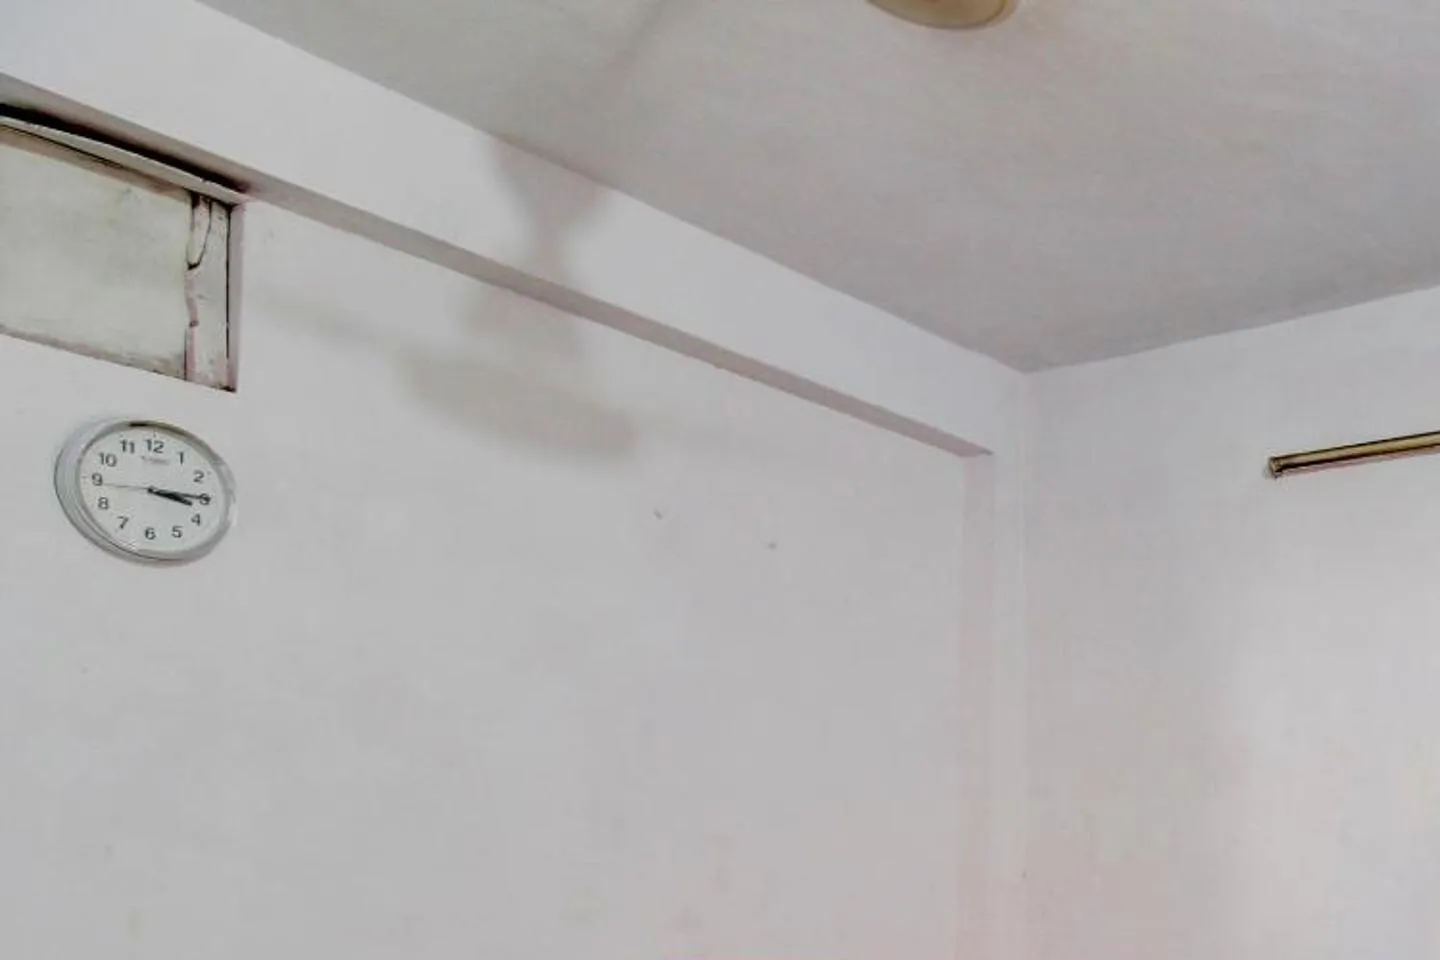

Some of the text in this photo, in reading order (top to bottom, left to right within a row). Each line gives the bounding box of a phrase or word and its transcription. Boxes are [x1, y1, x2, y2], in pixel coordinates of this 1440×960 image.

[120, 439, 135, 454] 11
[146, 439, 164, 453] 12
[100, 452, 117, 467] 10
[178, 452, 184, 464] 1
[92, 473, 103, 486] 9
[193, 470, 204, 482] 2
[98, 497, 109, 510] 8
[117, 516, 129, 529] 7
[191, 514, 201, 526] 4
[145, 527, 156, 540] 6
[172, 526, 183, 538] 5
